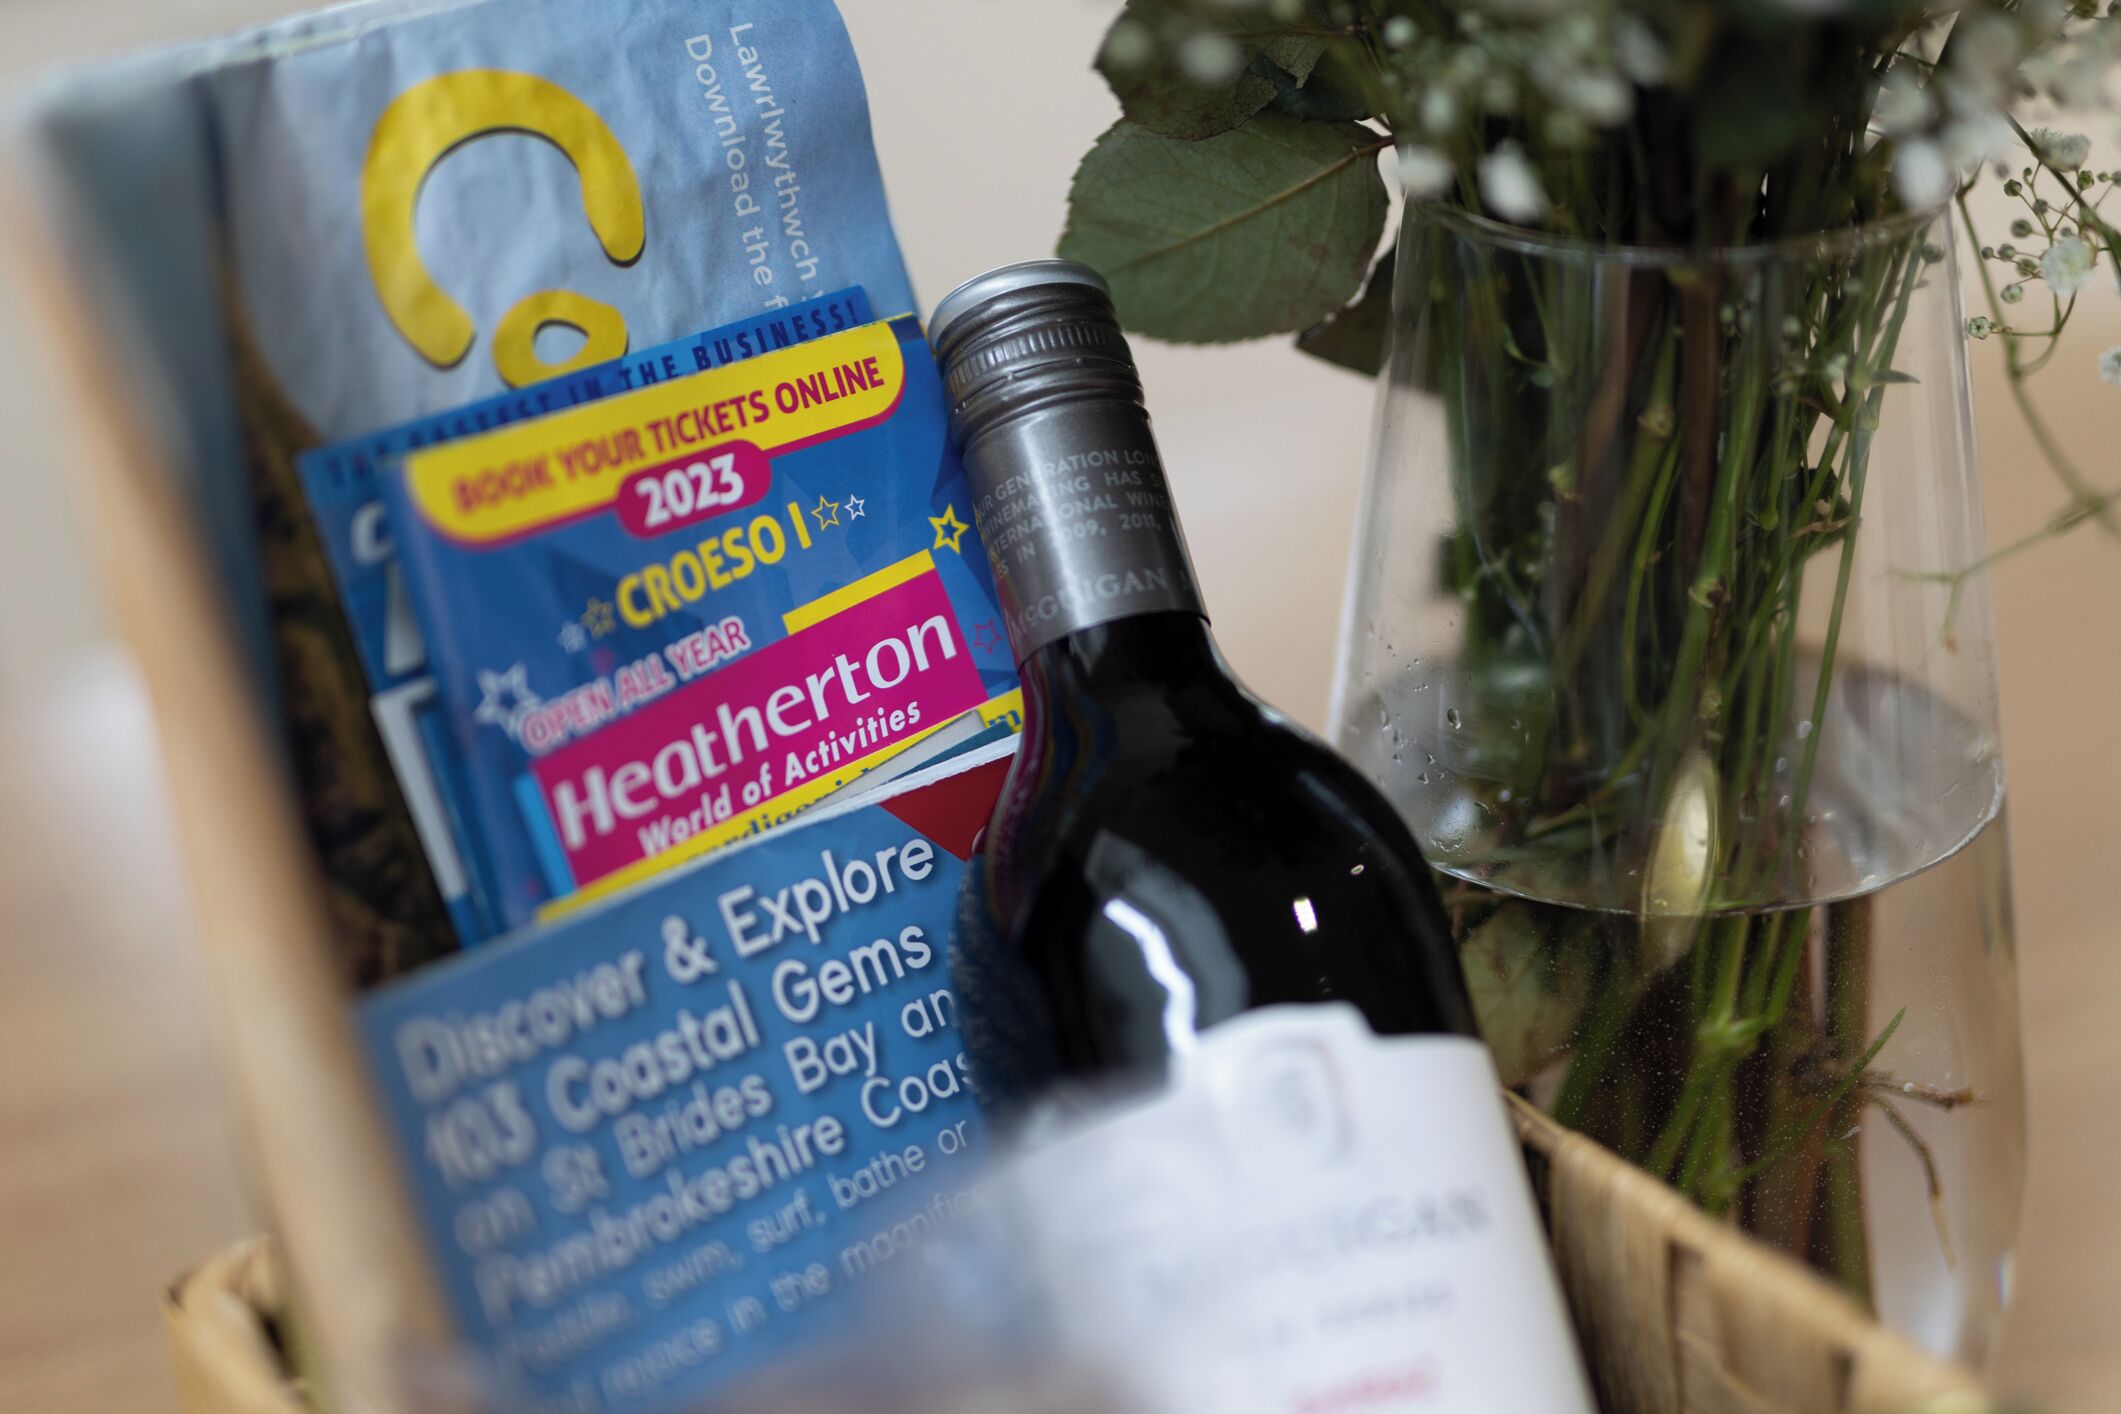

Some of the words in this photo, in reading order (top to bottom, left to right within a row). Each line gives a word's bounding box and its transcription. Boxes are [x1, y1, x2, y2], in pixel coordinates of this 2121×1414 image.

[685, 34, 760, 217] Download
[742, 226, 773, 285] the
[730, 22, 819, 280] Lawrlwythwch
[619, 354, 680, 393] THE
[691, 298, 862, 373] BUSINESS!
[452, 453, 556, 516] BOOK
[557, 428, 647, 480] YOUR
[646, 390, 770, 454] TICKETS
[774, 356, 885, 415] ONLINE
[635, 453, 744, 529] 2023
[1105, 471, 1142, 488] HAS
[616, 514, 785, 628] CROESO
[1016, 542, 1037, 565] IN
[520, 684, 613, 751] OPEN
[614, 651, 676, 713] ALL
[667, 615, 752, 680] YEAR
[552, 614, 958, 850] Heatherton
[637, 783, 733, 858] World
[742, 762, 772, 806] of
[785, 700, 921, 787] Activities
[398, 949, 648, 1104] Discover
[661, 916, 719, 985] &
[718, 839, 935, 957] Explore
[545, 979, 761, 1133] Coastal
[772, 924, 932, 1023] Gems
[613, 1073, 773, 1178] Brides
[784, 1021, 877, 1094] Bay
[901, 988, 957, 1039] an
[474, 1114, 846, 1327] Pembrokeshire
[861, 1049, 972, 1129] Coas
[826, 1145, 926, 1210] bathe
[938, 1118, 967, 1155] or
